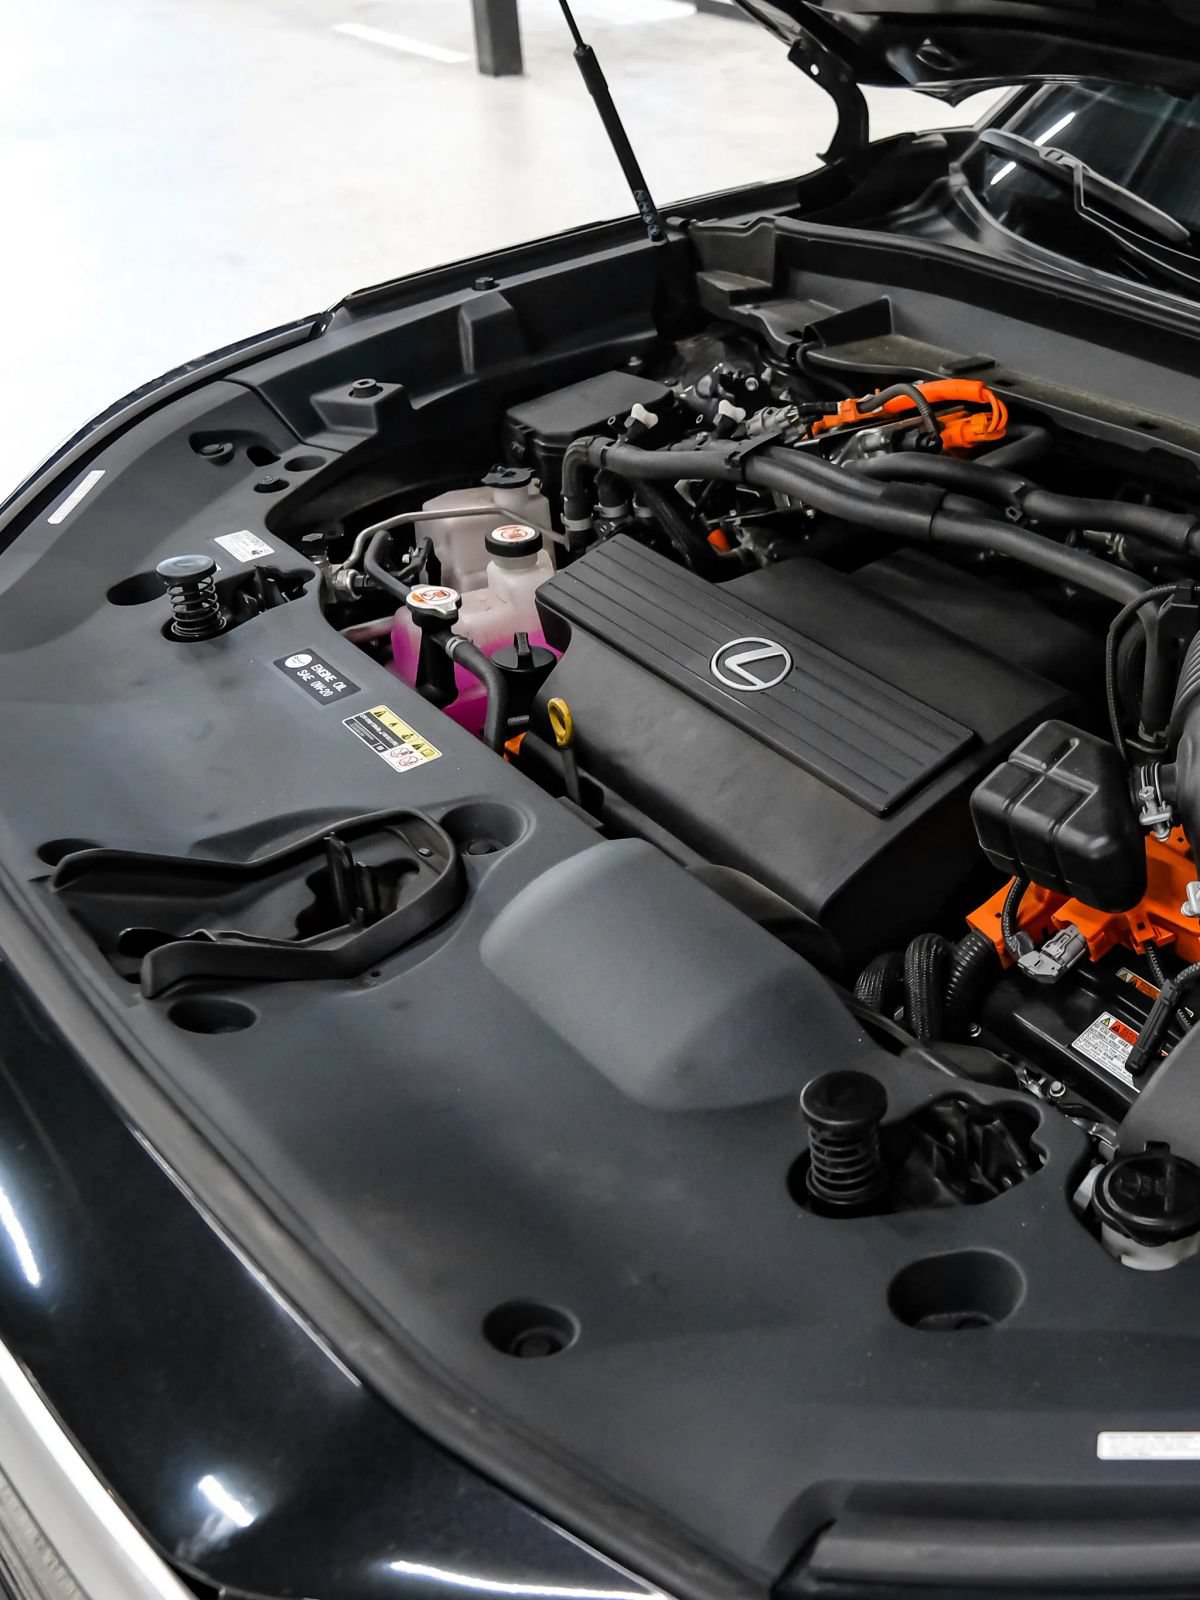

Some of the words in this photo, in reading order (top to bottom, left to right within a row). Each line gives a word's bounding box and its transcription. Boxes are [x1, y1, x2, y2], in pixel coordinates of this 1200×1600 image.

[297, 669, 315, 682] SAE
[311, 681, 333, 697] 0W-20
[310, 664, 337, 682] ENGINE
[333, 682, 347, 692] OIL
